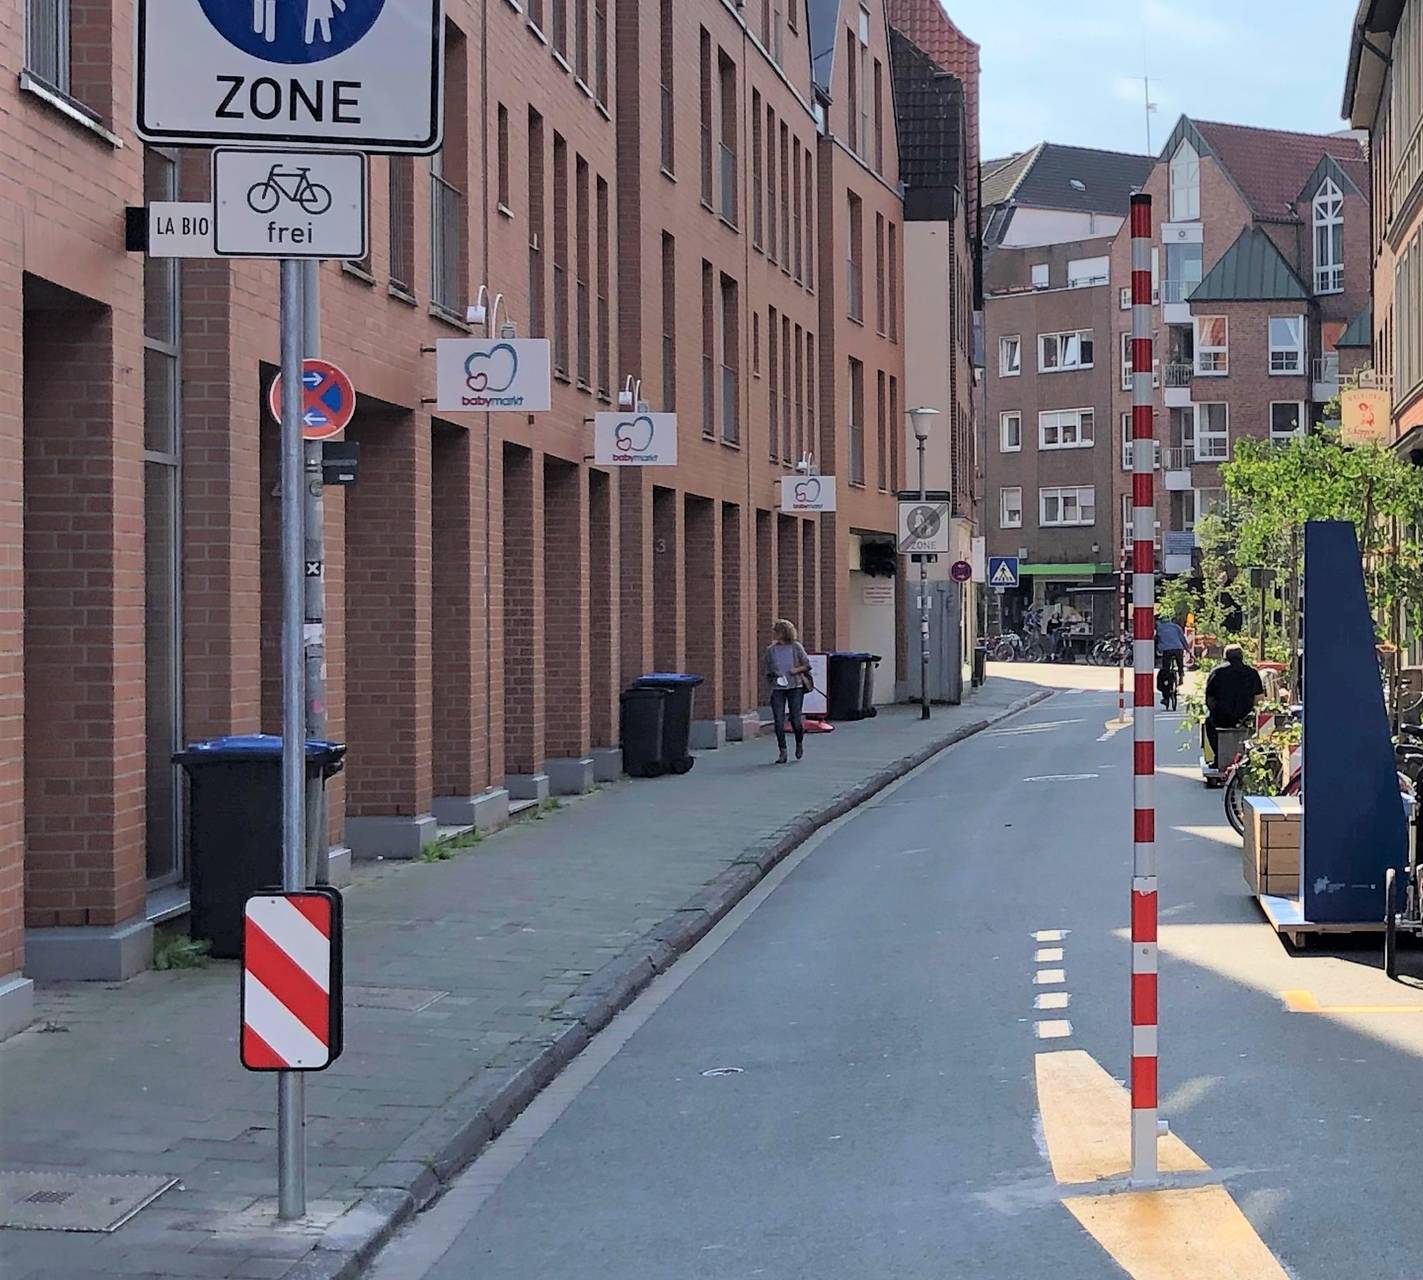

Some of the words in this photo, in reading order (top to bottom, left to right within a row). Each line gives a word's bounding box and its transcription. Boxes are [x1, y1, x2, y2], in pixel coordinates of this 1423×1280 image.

[215, 75, 362, 124] ZONE
[156, 216, 175, 236] LA
[267, 220, 313, 244] frei
[461, 395, 524, 408] babymarkt
[612, 453, 658, 463] babymarkt
[655, 538, 666, 554] 3
[910, 540, 937, 550] ZONE
